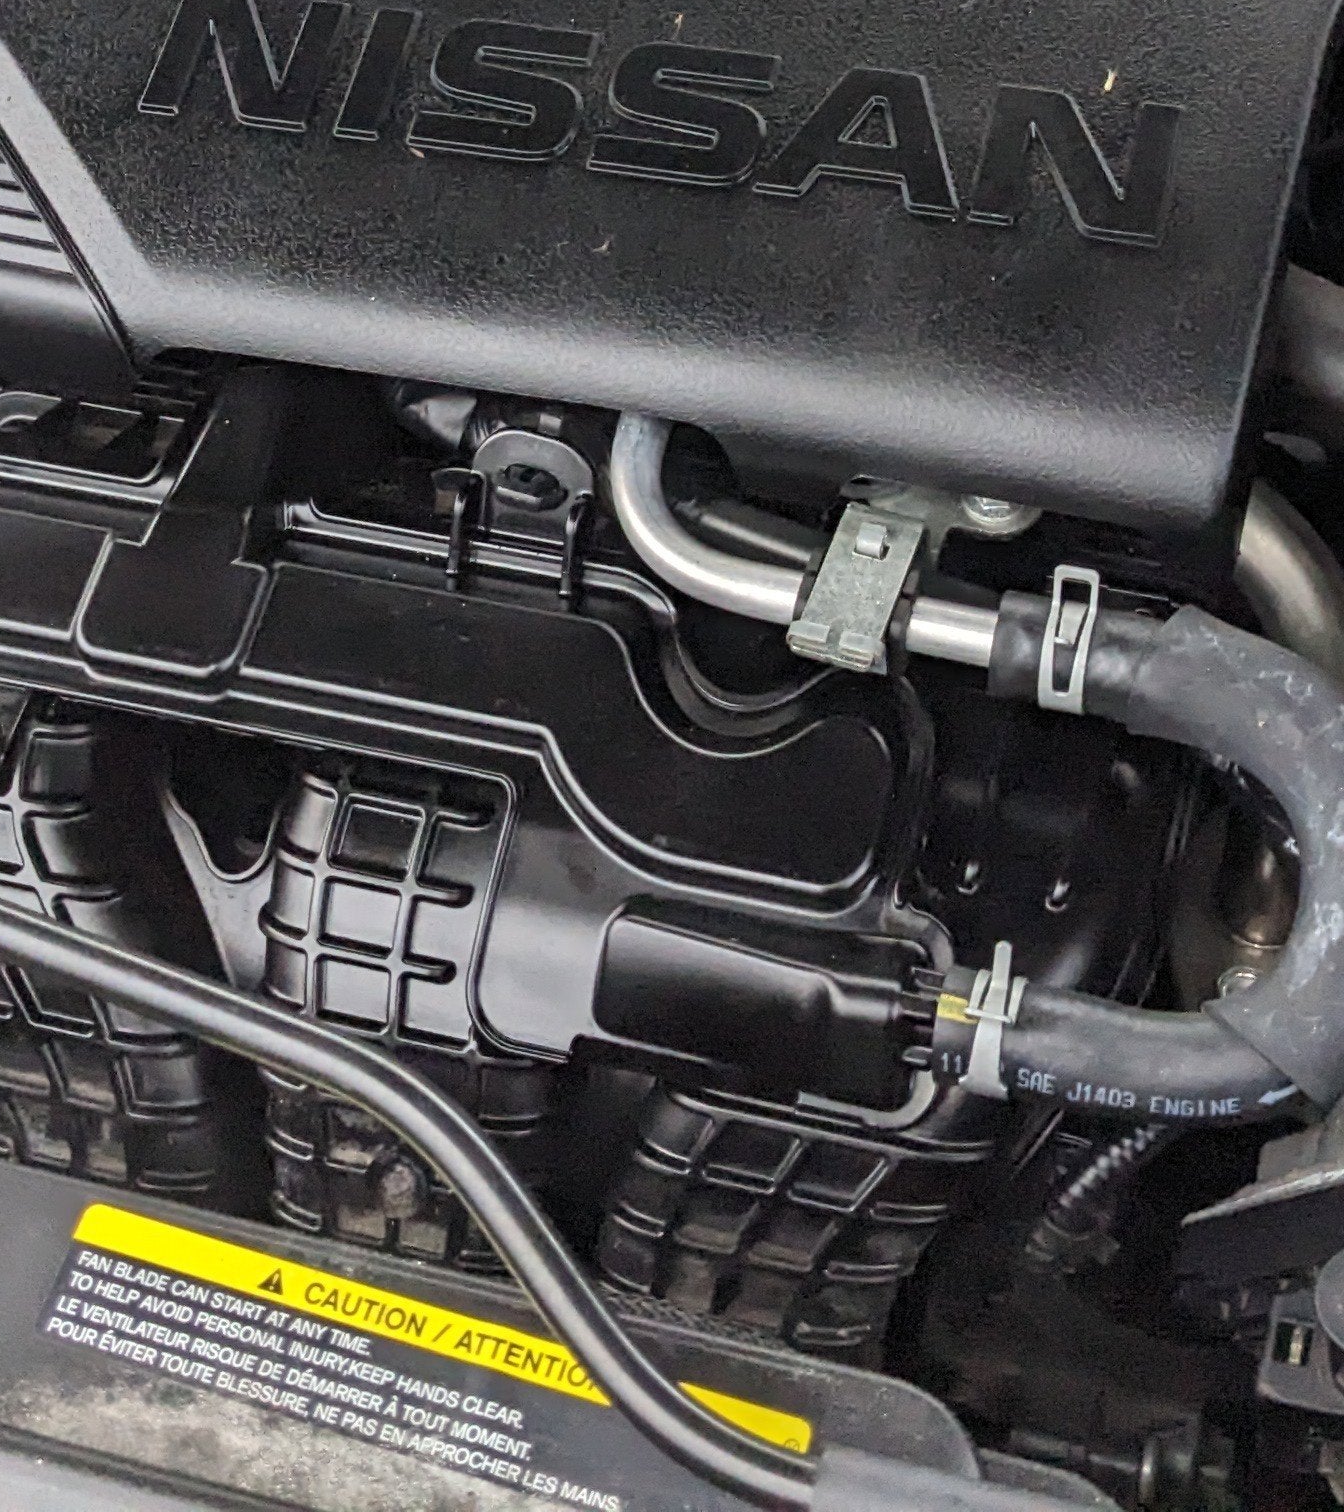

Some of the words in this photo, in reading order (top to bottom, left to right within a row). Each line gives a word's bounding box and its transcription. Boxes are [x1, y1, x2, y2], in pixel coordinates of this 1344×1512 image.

[1017, 1067, 1056, 1095] SAE
[1067, 1081, 1137, 1109] J1403
[1149, 1095, 1243, 1117] ENGINE
[70, 1270, 94, 1289] TO
[94, 1278, 141, 1305] HELP
[139, 1295, 194, 1324] AVOID
[193, 1311, 286, 1355] PERSONAL
[395, 1373, 461, 1408] HANDS
[461, 1394, 525, 1430] CLEAR.
[77, 1250, 112, 1275] FAN
[113, 1261, 171, 1291] BLADE
[171, 1279, 211, 1304] CAN
[210, 1290, 266, 1321] START
[265, 1310, 290, 1329] AT
[288, 1316, 329, 1341] ANY
[329, 1328, 372, 1357] TIME.
[304, 1282, 428, 1338] CAUTION
[45, 1316, 98, 1347] POUR
[97, 1328, 158, 1366] ÉVITER
[158, 1351, 217, 1385] TOUTE
[312, 1402, 340, 1425] NE
[340, 1411, 378, 1437] PAS
[379, 1422, 408, 1447] EN
[407, 1435, 523, 1484] APPROCHER
[522, 1468, 560, 1495] LES
[56, 1295, 79, 1317] LE
[81, 1302, 191, 1350] VENTILATEUR
[189, 1337, 255, 1373] RISQUE
[257, 1359, 285, 1382] DE
[284, 1368, 384, 1414] DÉMARRER
[384, 1394, 398, 1419] À
[402, 1403, 451, 1433] TOUT
[450, 1420, 532, 1462] MOMENT.
